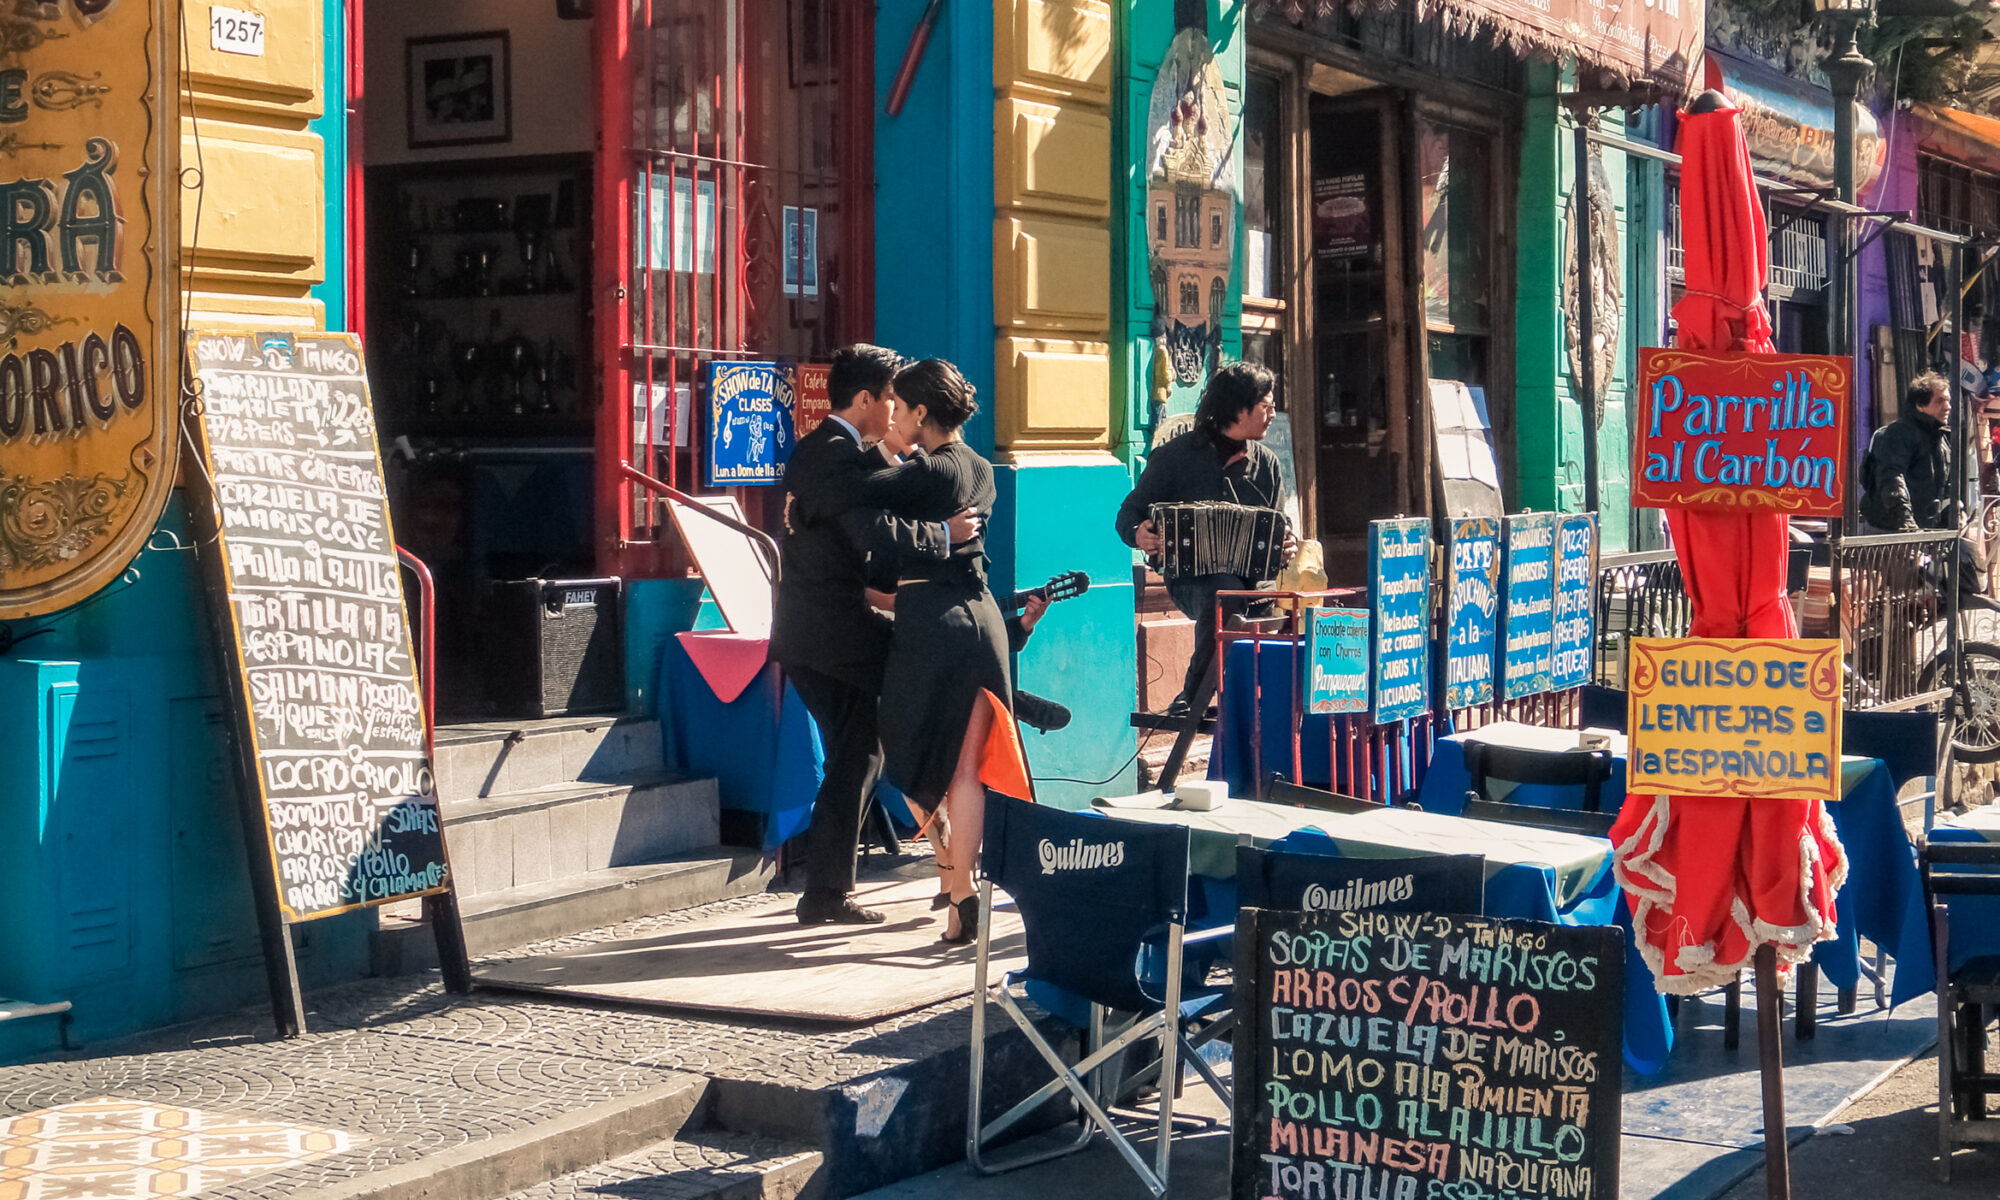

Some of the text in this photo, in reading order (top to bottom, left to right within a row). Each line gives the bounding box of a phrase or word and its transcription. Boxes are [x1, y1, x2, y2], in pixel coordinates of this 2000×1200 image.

[214, 17, 260, 44] 1257
[196, 337, 246, 362] SHOW
[294, 341, 360, 375] TANGO
[203, 371, 330, 408] PARRILLADA
[718, 371, 794, 408] SHOW de TANGO
[738, 396, 773, 412] CLASES
[802, 392, 831, 414] Empana
[1648, 370, 1835, 438] Parrilla
[214, 450, 383, 496] PASTAS CASERAS
[1645, 437, 1835, 498] al Carbón
[219, 482, 382, 529] CAZUELA DE
[223, 506, 368, 550] MARISCOS
[1562, 527, 1590, 555] PIZZA
[227, 543, 301, 583] POLLO
[328, 557, 402, 598] AJILLO
[1454, 540, 1492, 570] CAFE
[1560, 555, 1589, 587] CASERA
[231, 592, 360, 639] TORTILLA
[565, 590, 597, 604] FAHEY
[1450, 577, 1495, 628] CAPUCHINO
[1557, 588, 1589, 620] PASTAS
[1383, 609, 1420, 633] Helados
[1459, 618, 1479, 646] a la
[1554, 616, 1590, 650] CASERAS
[1394, 633, 1422, 652] cream
[248, 670, 358, 705] SALMON
[1383, 657, 1418, 681] JUGOS Y
[1449, 653, 1491, 685] ITALIANA
[1660, 658, 1808, 689] GUISO DE
[1380, 683, 1422, 708] LICUADOS
[1639, 703, 1826, 734] LENTEJAS a
[266, 757, 434, 798] LOCRO CRIOLLO
[1635, 739, 1830, 779] la ESPAÑOLA
[282, 852, 349, 884] ARROS
[1038, 837, 1125, 876] Quilmes
[1303, 873, 1415, 911] Quilmes
[1269, 930, 1598, 991] SOPAS DE MARISCOS
[1272, 967, 1383, 1014] ARROS
[1271, 1006, 1599, 1083] CAZUELA DE MARISCOS
[1272, 1046, 1387, 1094] LOMO
[1265, 1081, 1586, 1162] POLLO AL AJILLO
[1270, 1117, 1592, 1200] MILANESA NAPOLITANA
